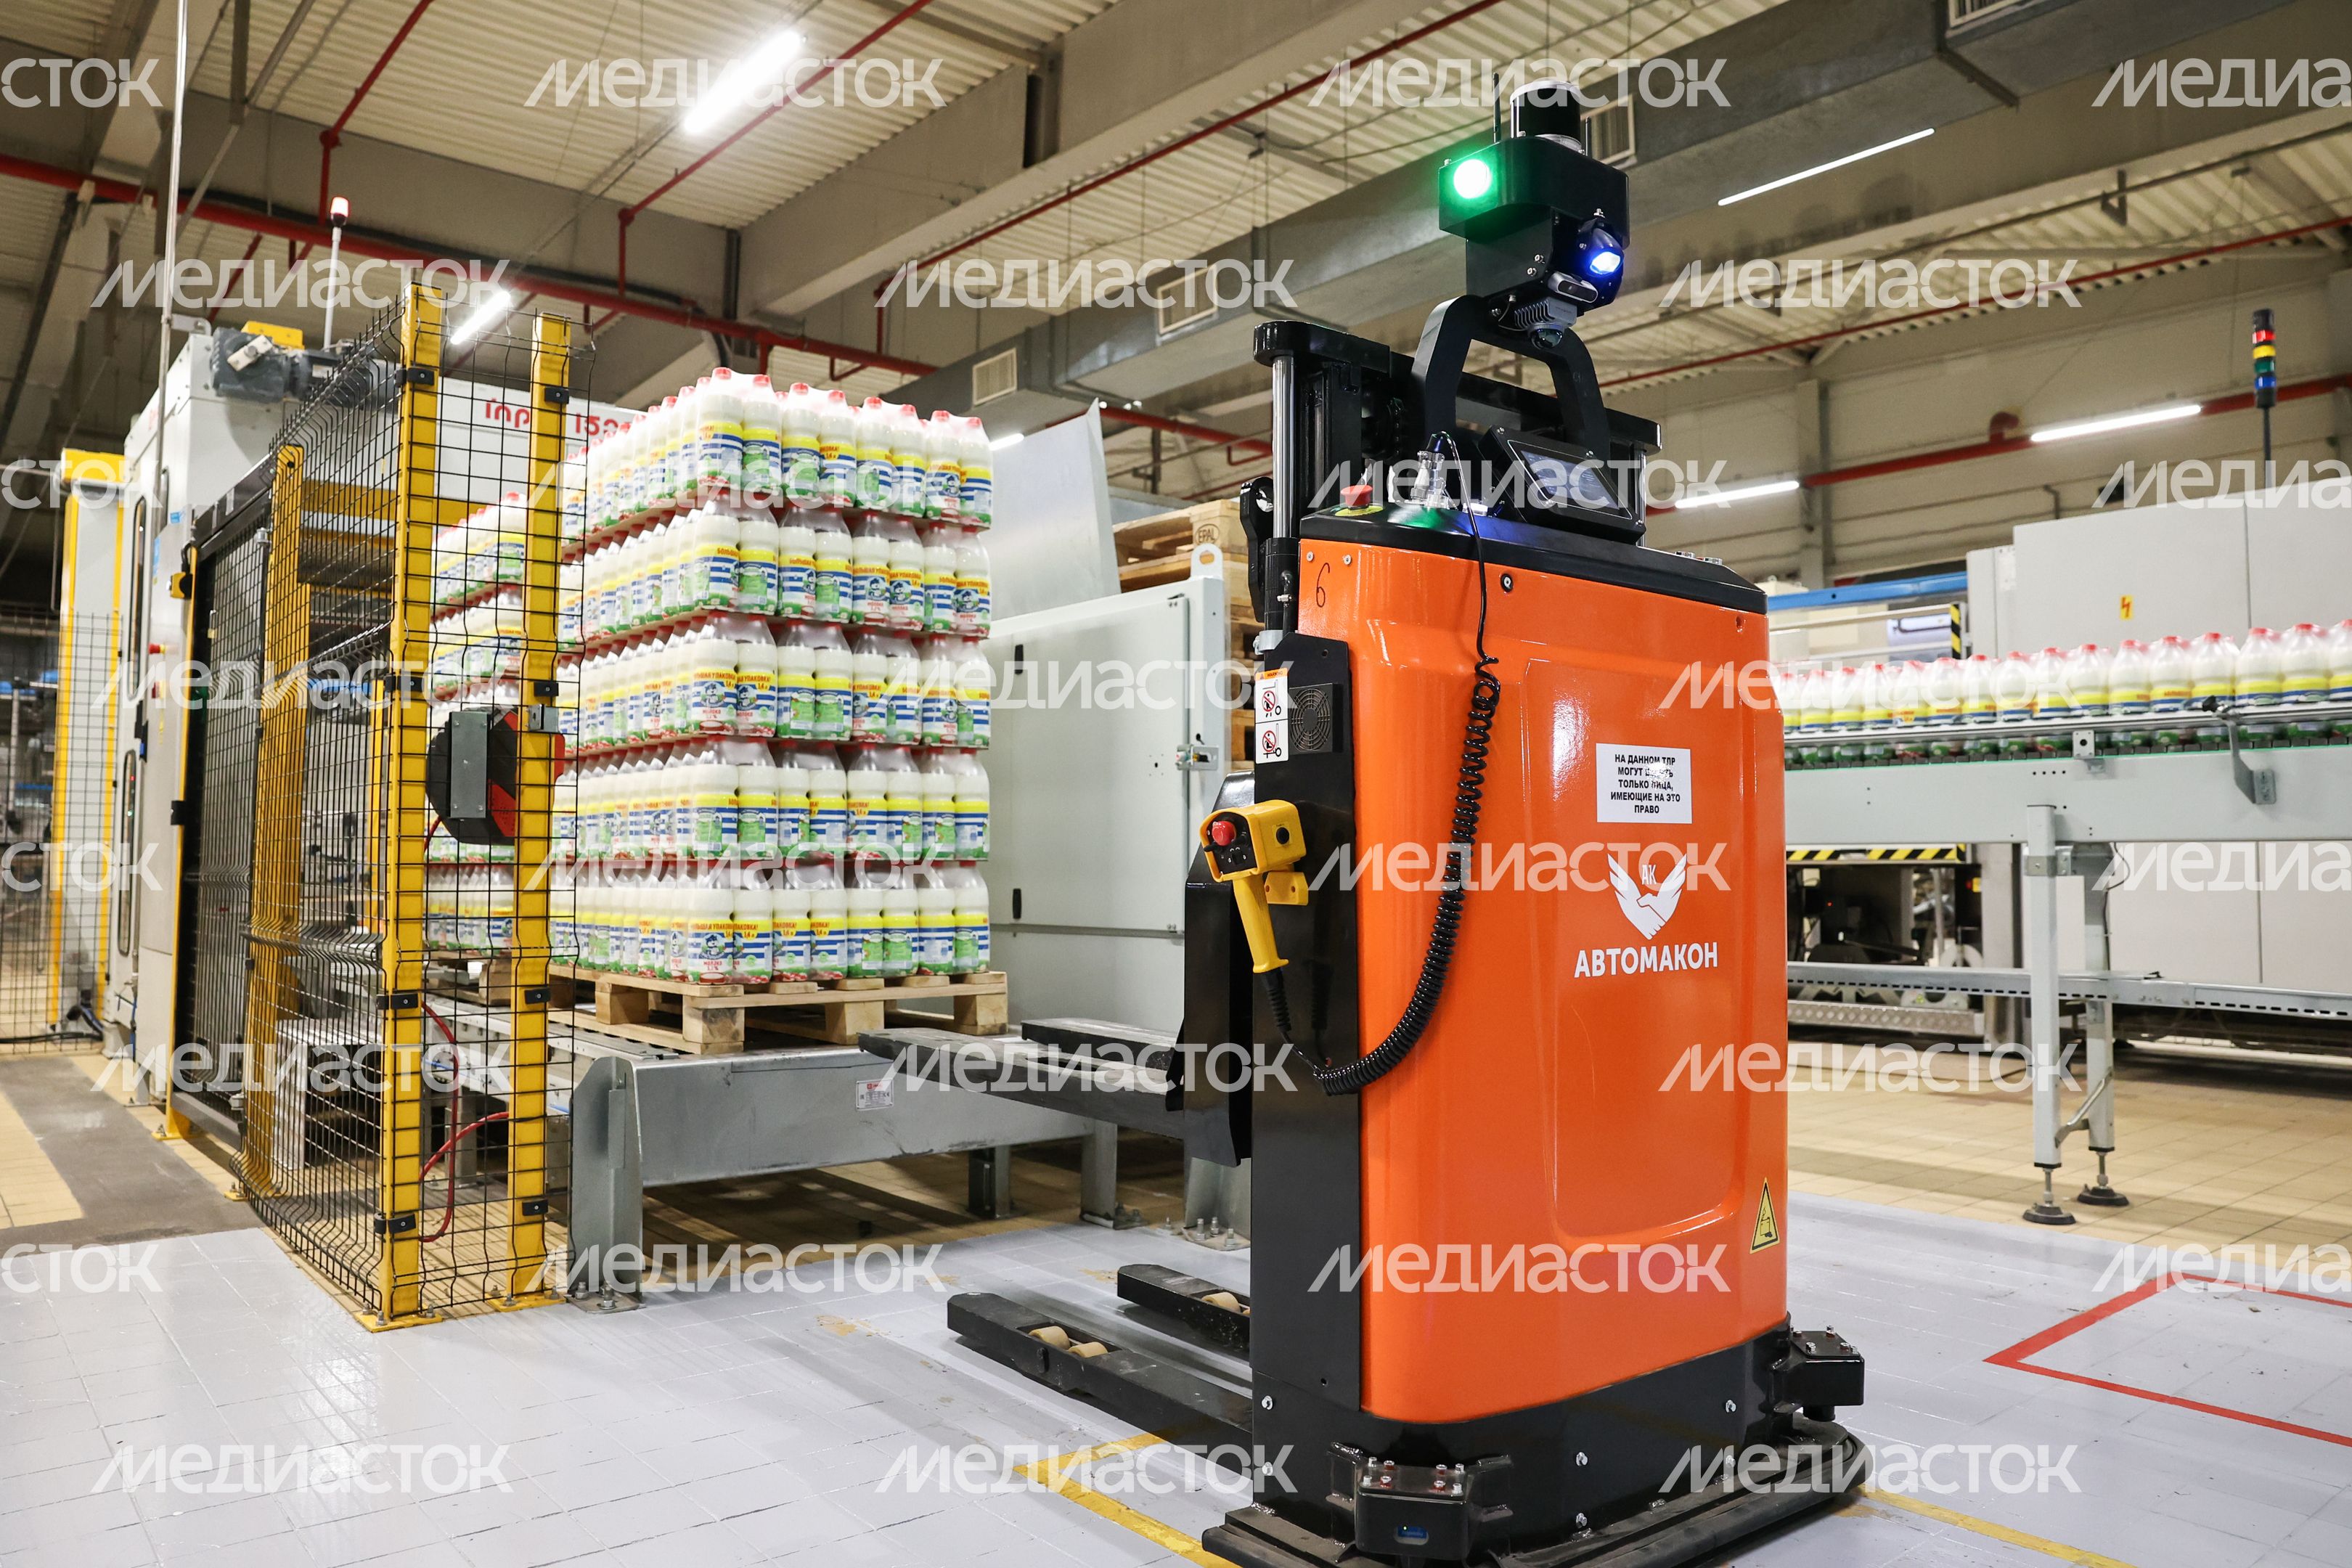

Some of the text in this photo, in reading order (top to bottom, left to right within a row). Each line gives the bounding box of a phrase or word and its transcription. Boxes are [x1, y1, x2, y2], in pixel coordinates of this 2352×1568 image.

[1198, 527, 1215, 542] EPAL
[1315, 562, 1331, 608] 6
[1615, 754, 1625, 763] НА
[1628, 755, 1660, 764] ДАННОМ
[1618, 767, 1643, 776] МОГУТ
[1618, 780, 1649, 788] ТОЛЬКО
[1611, 792, 1681, 802] ИМЕЮЩИЕ НА ЭТО
[1641, 864, 1657, 885] АК
[1574, 942, 1718, 978] АВТОМАКОН
